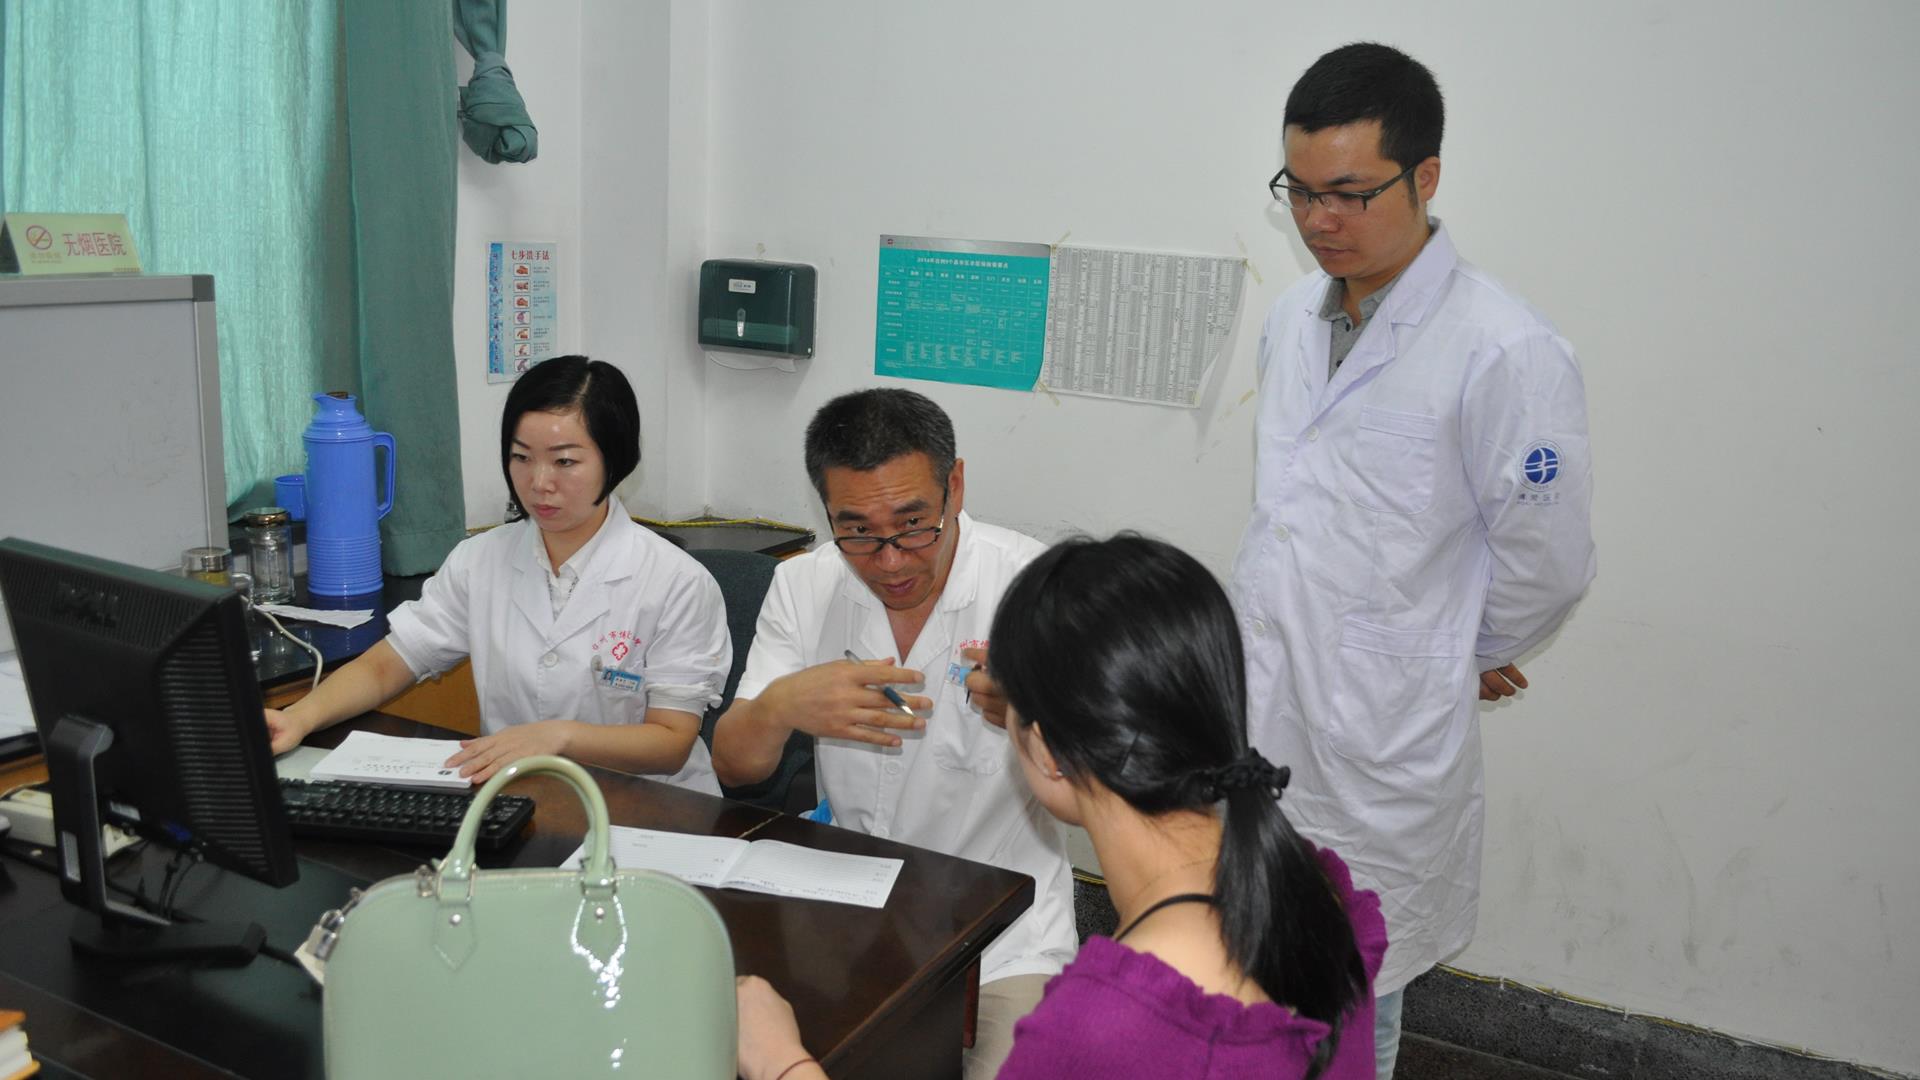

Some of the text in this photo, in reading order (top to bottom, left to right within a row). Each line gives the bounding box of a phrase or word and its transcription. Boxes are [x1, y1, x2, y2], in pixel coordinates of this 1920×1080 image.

[62, 232, 127, 256] 无烟医院
[511, 249, 550, 261] 七步洗手法
